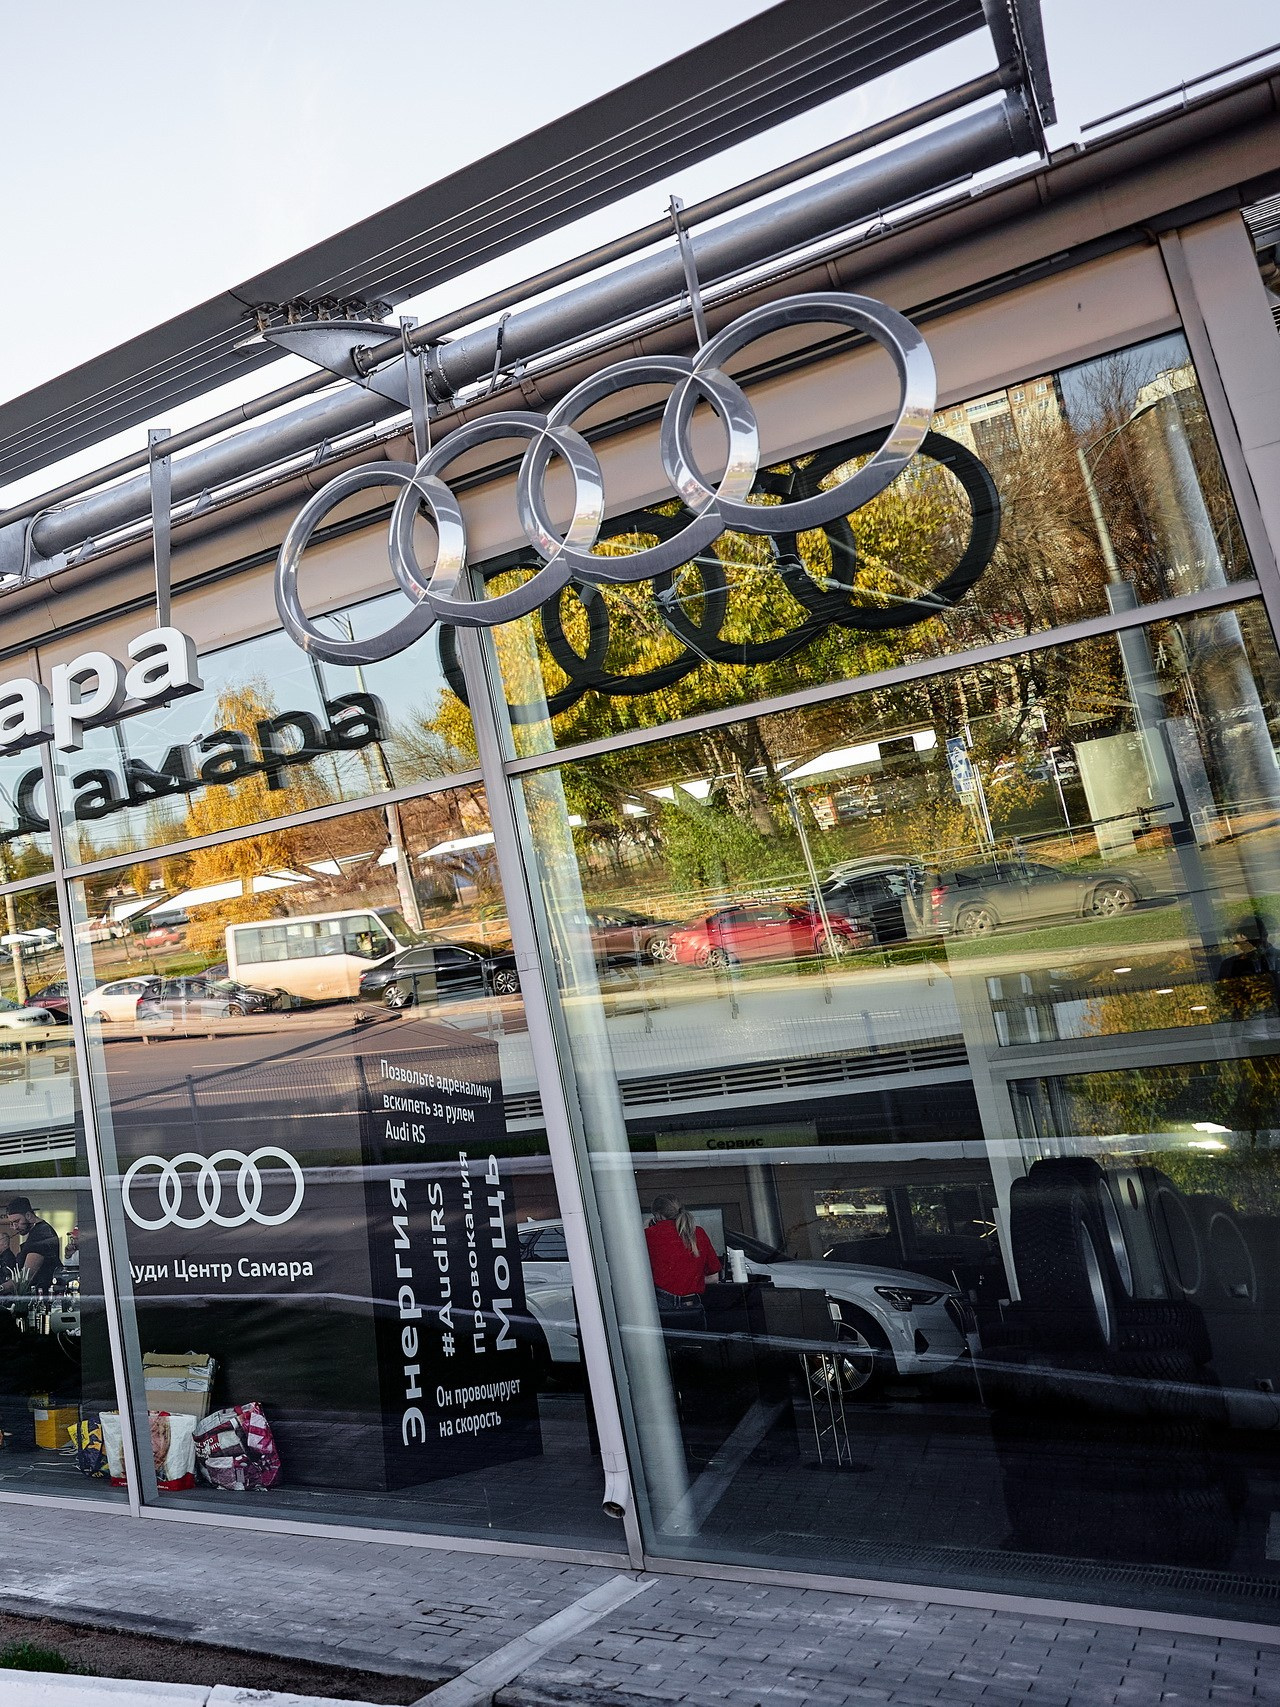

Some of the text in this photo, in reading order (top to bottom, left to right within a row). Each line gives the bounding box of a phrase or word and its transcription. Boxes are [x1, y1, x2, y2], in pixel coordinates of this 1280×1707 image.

[380, 1059, 492, 1104] Позвольте адреналину
[383, 1094, 475, 1125] вскипеть за рулем
[385, 1120, 426, 1144] Audi RS
[706, 1138, 764, 1150] Сервис
[458, 1151, 486, 1354] Провокация
[485, 1154, 517, 1351] Мощь
[173, 1259, 233, 1283] Центр
[237, 1257, 314, 1282] Самара
[428, 1182, 456, 1358] #AudiRS
[389, 1178, 426, 1446] Энергия
[436, 1379, 520, 1409] Он провоцирует
[439, 1411, 502, 1438] на скорость
